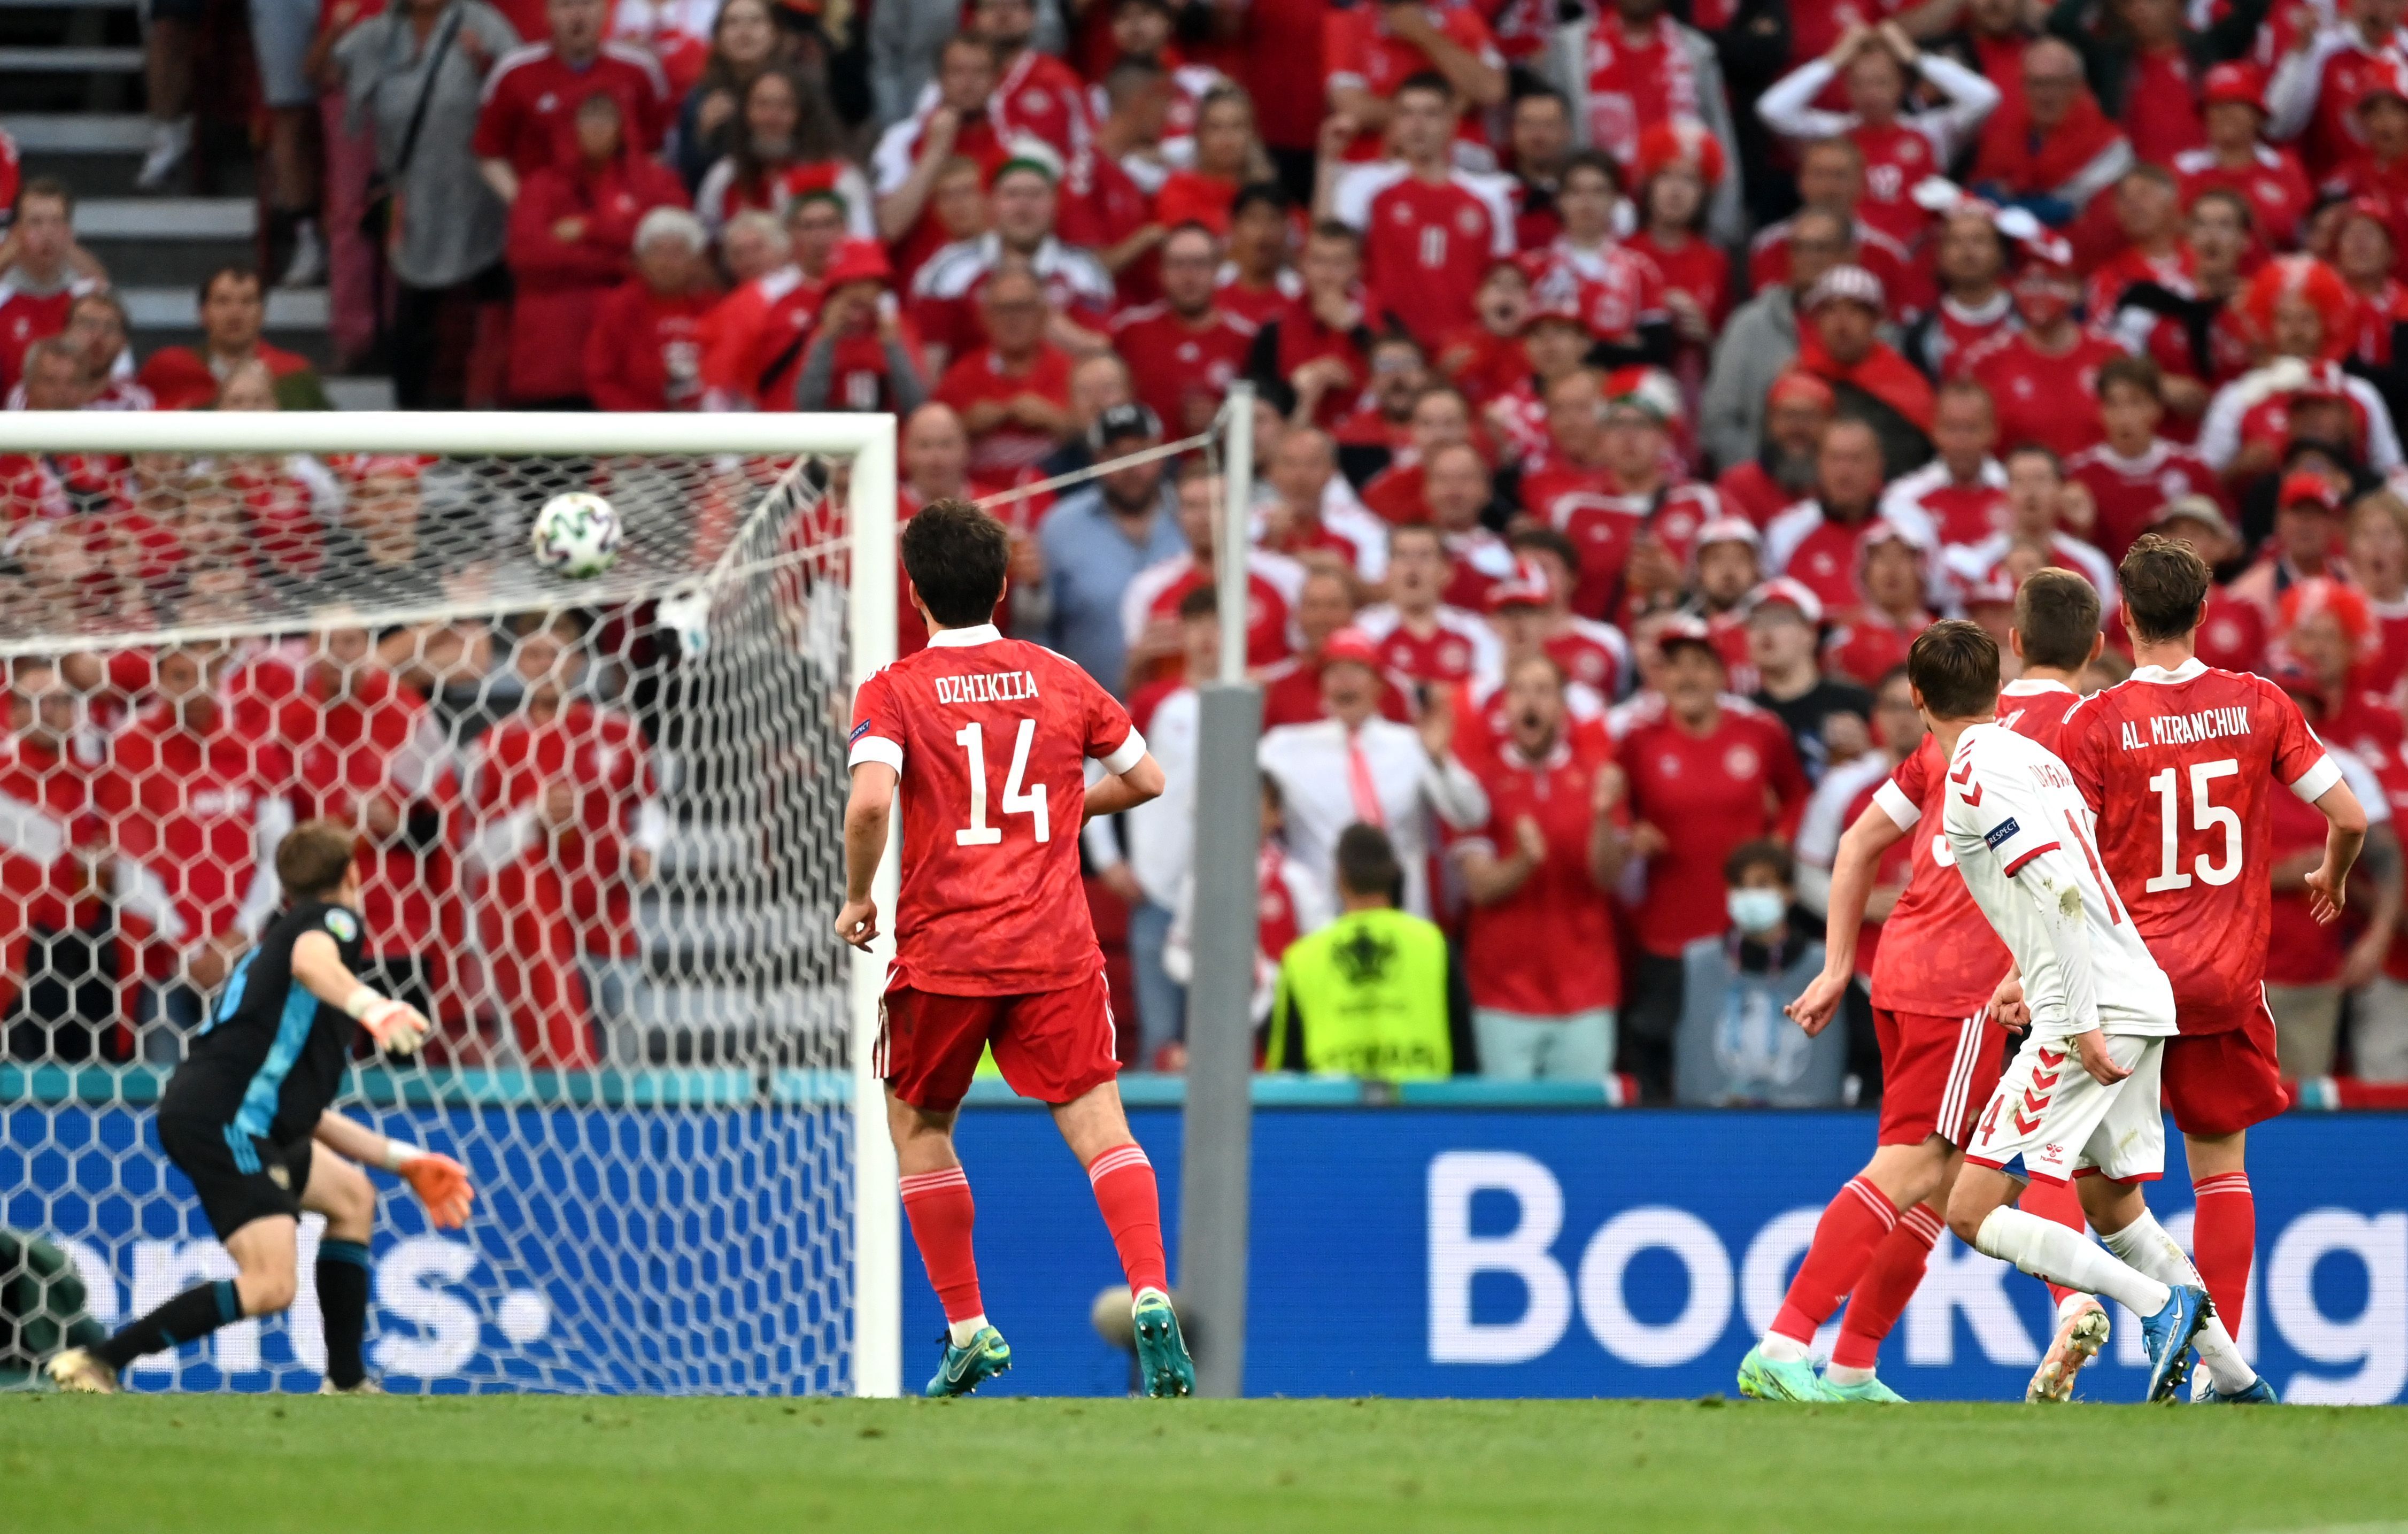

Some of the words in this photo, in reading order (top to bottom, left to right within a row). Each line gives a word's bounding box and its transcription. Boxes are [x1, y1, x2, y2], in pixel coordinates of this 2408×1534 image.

[935, 670, 1039, 705] DZHIKIIA
[2121, 722, 2149, 751] AL.
[2150, 706, 2251, 746] MIRANCHUK
[955, 718, 1049, 846] 14
[1988, 821, 2017, 845] RESPECT
[2145, 758, 2242, 893] 15
[1979, 1094, 2005, 1147] 4
[2040, 1155, 2063, 1165] hummel
